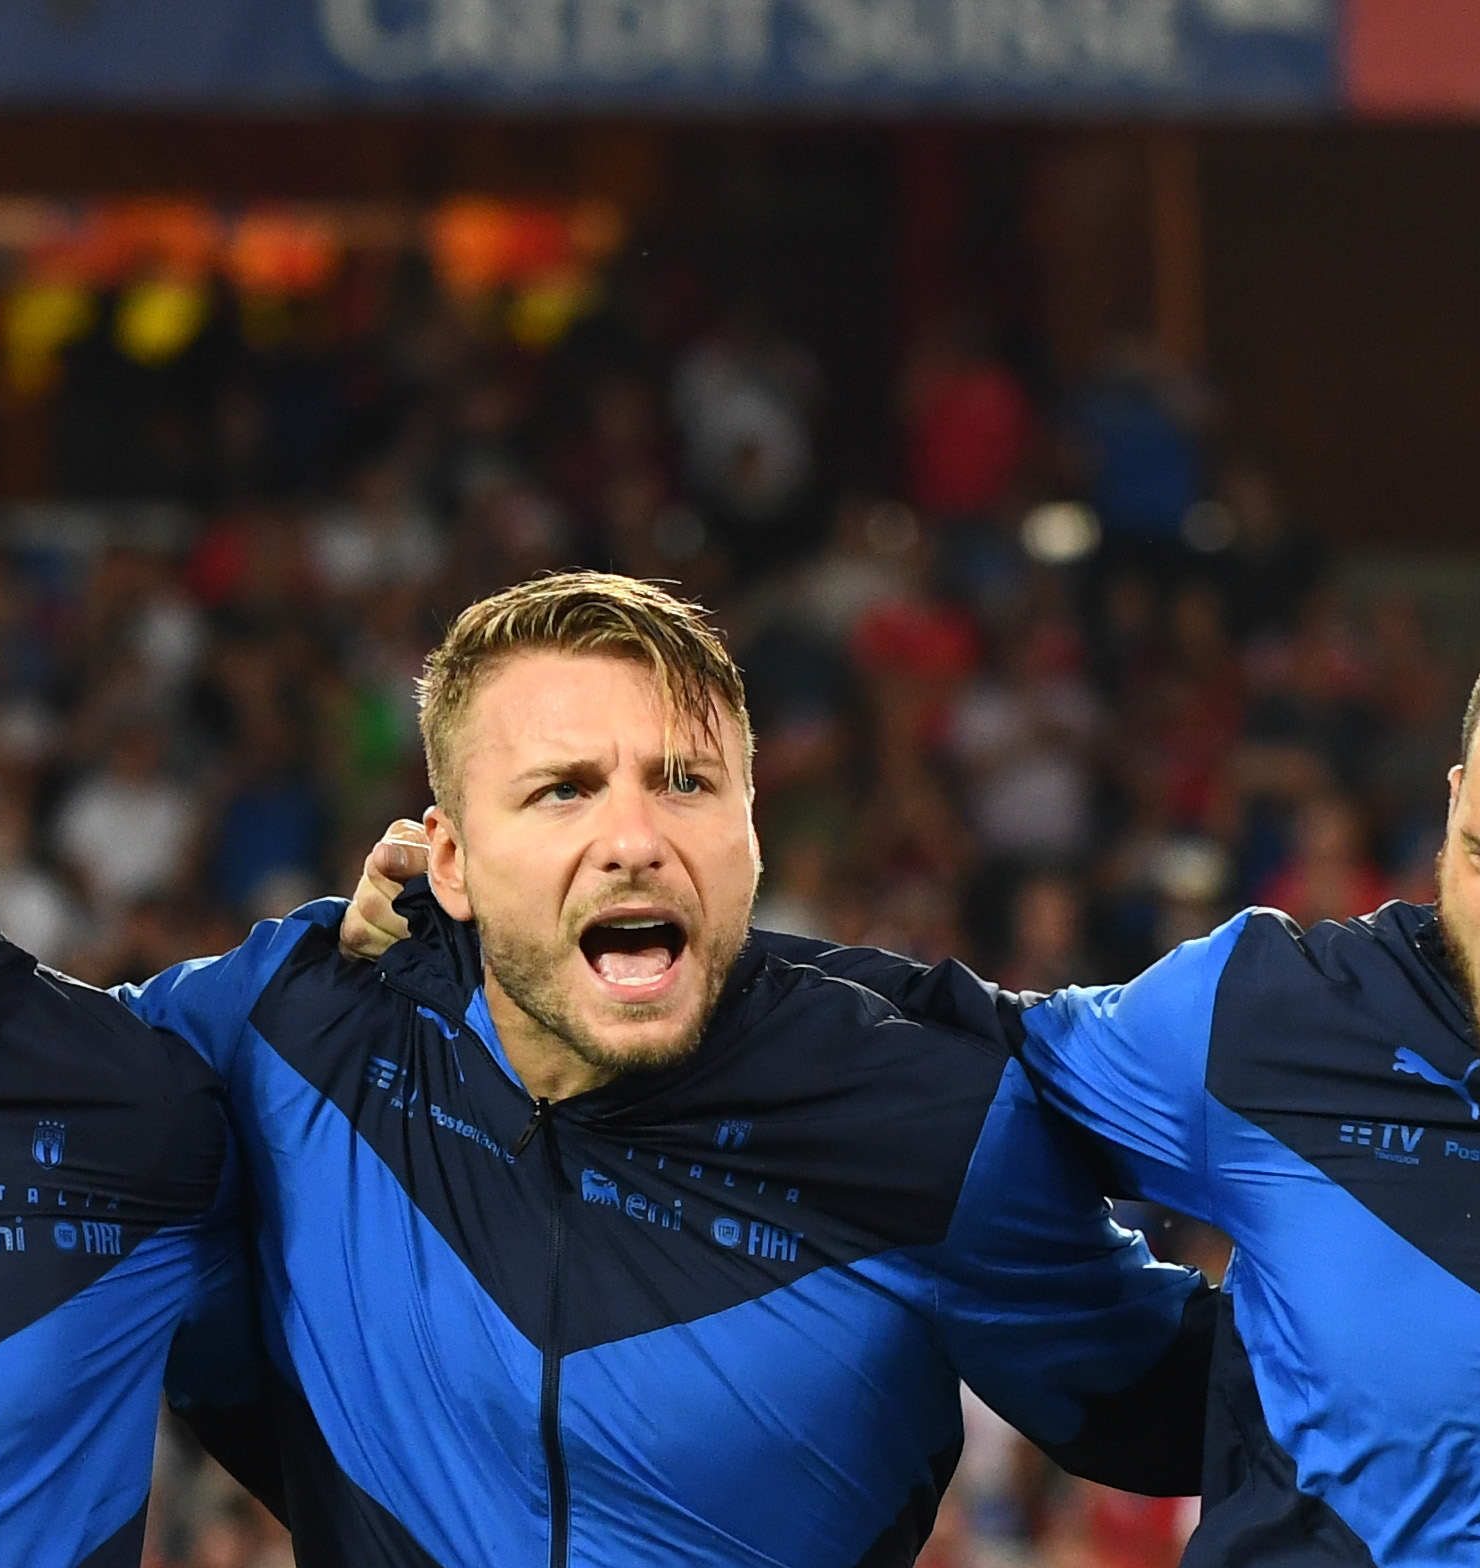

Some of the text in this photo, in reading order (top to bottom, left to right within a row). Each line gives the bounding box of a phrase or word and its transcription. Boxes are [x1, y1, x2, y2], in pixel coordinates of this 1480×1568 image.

[1379, 1123, 1425, 1153] TV
[625, 1146, 800, 1204] ITALIA
[81, 1220, 123, 1256] FIAT
[747, 1220, 805, 1263] FIAT
